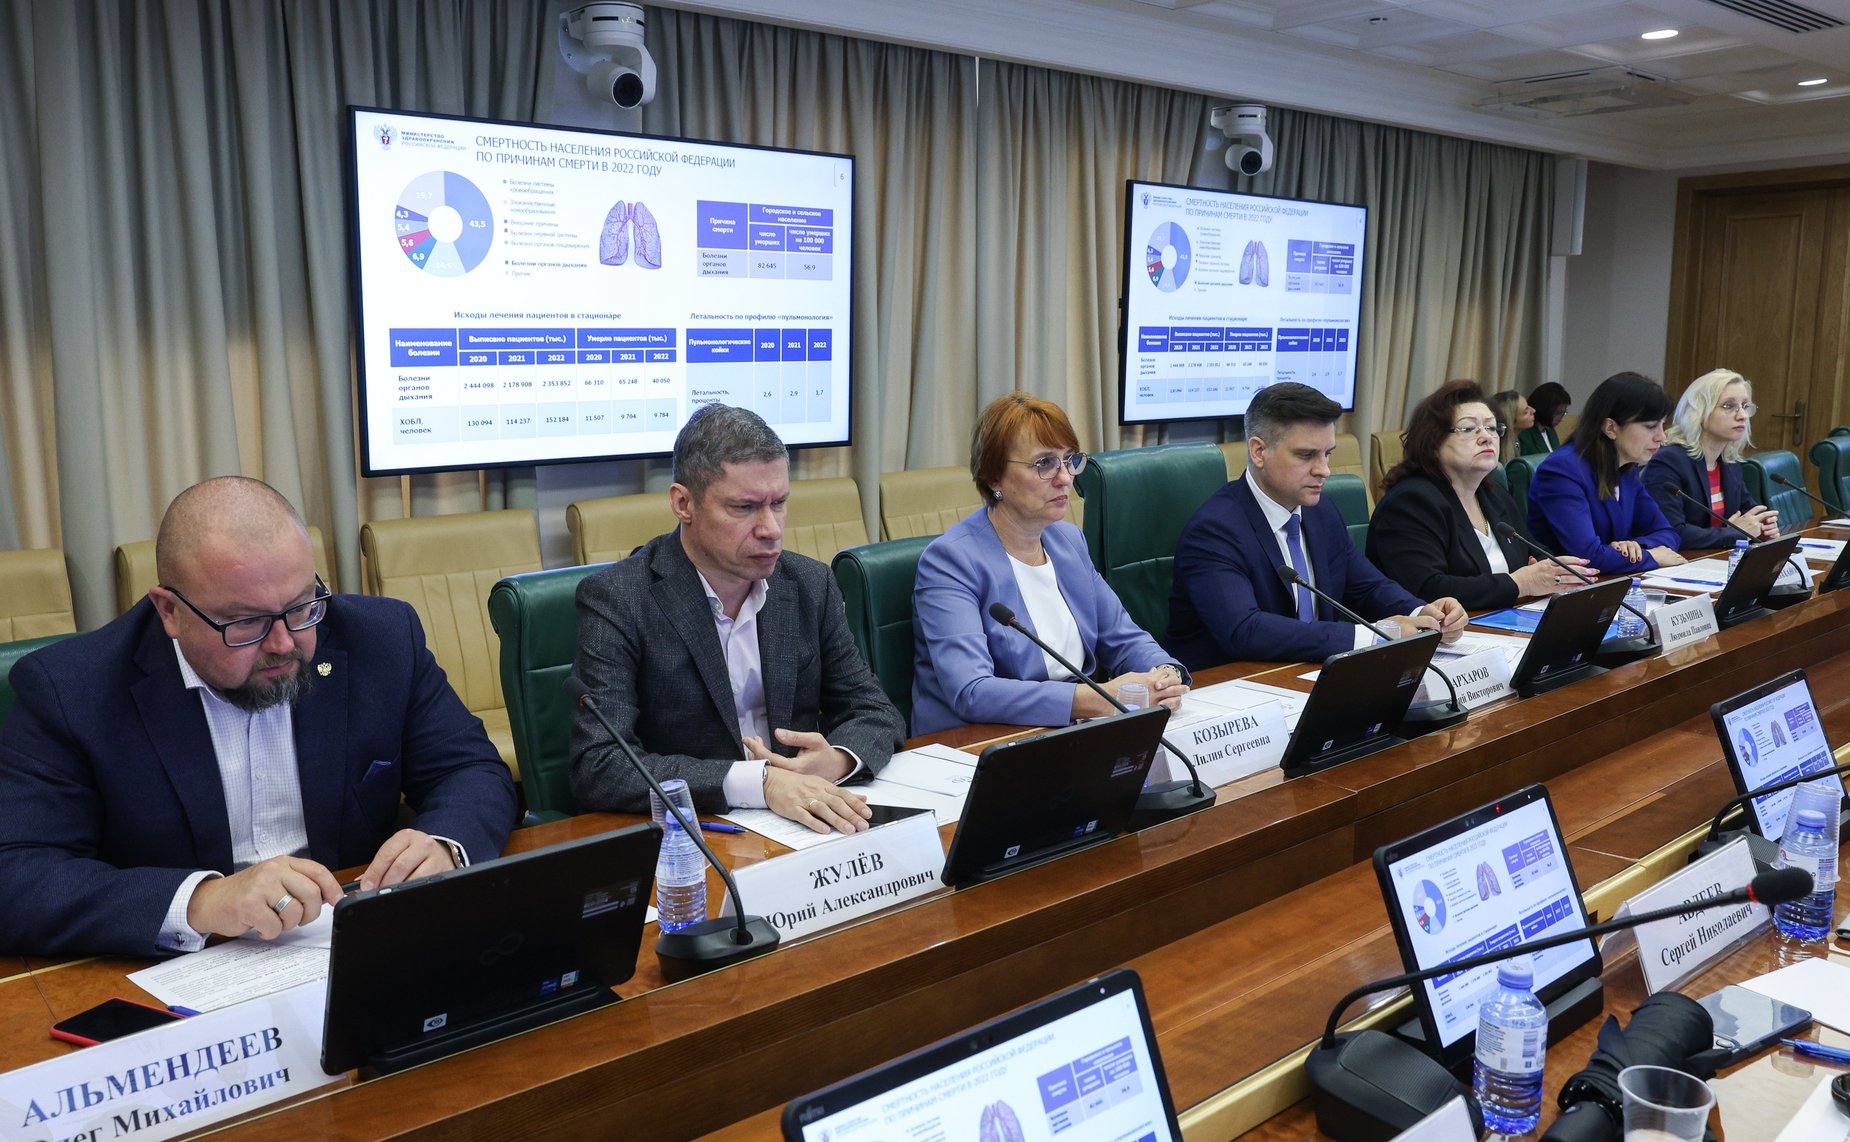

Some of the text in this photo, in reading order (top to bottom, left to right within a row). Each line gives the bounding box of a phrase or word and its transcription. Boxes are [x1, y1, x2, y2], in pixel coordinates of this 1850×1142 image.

[401, 131, 445, 139] МИНИСТЕРСТВО
[475, 135, 736, 168] СМЕРТНОСТЬ НАСЕЛЕНИЯ РОССИЙСКОЙ ФЕДЕРАЦИИ
[476, 151, 662, 177] ПО ПРИЧИНАМ СМЕРТИ В 2022 ГОДУ
[1185, 197, 1219, 208] СМЕРТНОСТЬ
[1220, 201, 1249, 210] НАСЕЛЕНИЯ
[396, 210, 409, 219] 4,3
[1185, 208, 1194, 216] ПО
[468, 220, 487, 229] 43,5
[709, 217, 736, 226] Причина
[397, 223, 410, 232] 5,4
[401, 238, 414, 248] 5,6
[412, 252, 425, 261] 6,9
[454, 311, 487, 319] Исходы
[526, 312, 568, 320] пациентов
[577, 312, 621, 320] стационаре
[395, 339, 453, 348] Наименование
[468, 334, 566, 344] Выписано пациентов (тыс.)
[587, 335, 612, 343] Умерло
[407, 349, 441, 357] болезни
[469, 355, 488, 363] 2020
[398, 384, 430, 392] органов
[400, 418, 423, 426] ХОБЛ,
[399, 427, 432, 435] человек
[1670, 609, 1703, 626] КУЗЬМИНА
[1452, 666, 1489, 688] АРХАРОВ
[1466, 682, 1504, 701] Викторович
[1192, 714, 1259, 745] КОЗЫРЕВА
[1192, 734, 1271, 768] Лилия Сергеевна
[809, 852, 884, 890] ЖУЛЁВ
[765, 870, 935, 930] Юрий Александрович
[1661, 903, 1753, 966] Сергей Николаевич
[22, 1026, 283, 1129] АЛЬМЕНДЕЕВ
[112, 1067, 291, 1138] Михайлович
